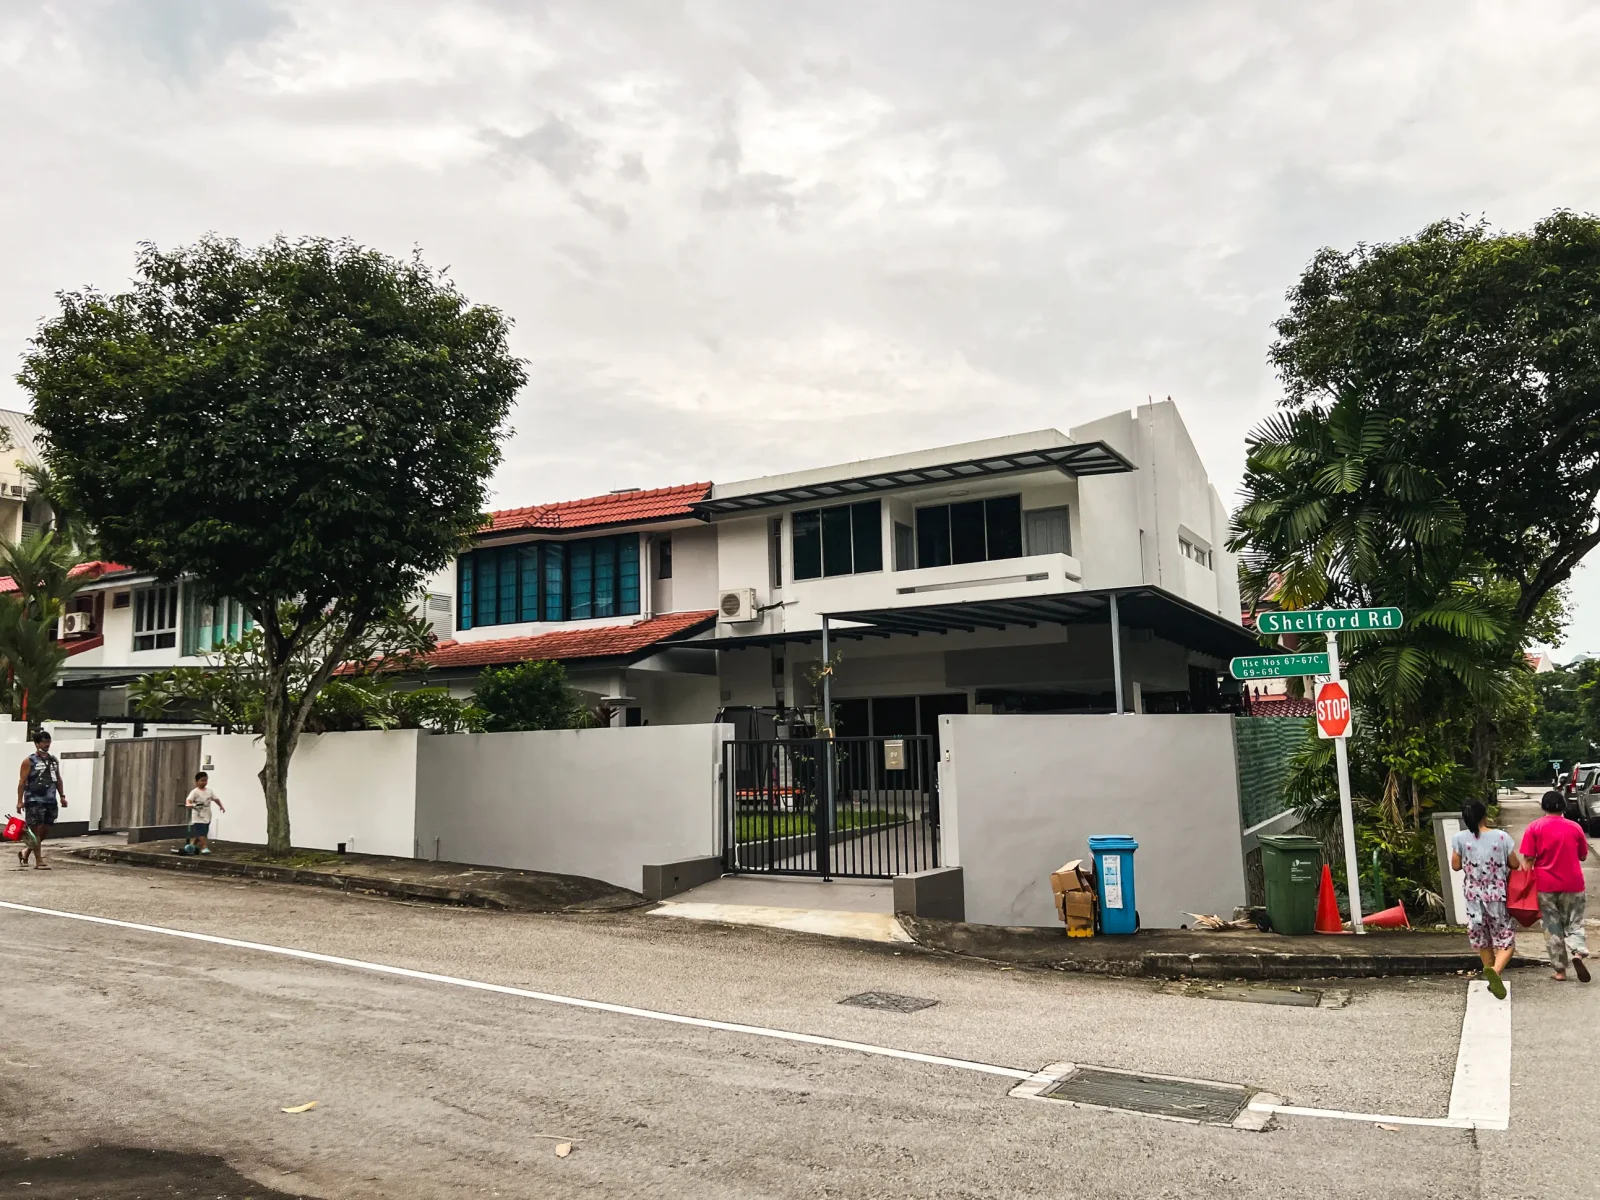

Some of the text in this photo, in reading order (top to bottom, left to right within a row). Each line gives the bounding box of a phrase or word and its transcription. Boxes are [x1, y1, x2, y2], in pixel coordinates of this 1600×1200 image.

[1269, 611, 1392, 631] Shelford Rd
[1242, 655, 1324, 668] Hse Nos 67-67C,
[1243, 667, 1280, 677] 69-69C
[1318, 697, 1348, 721] STOP
